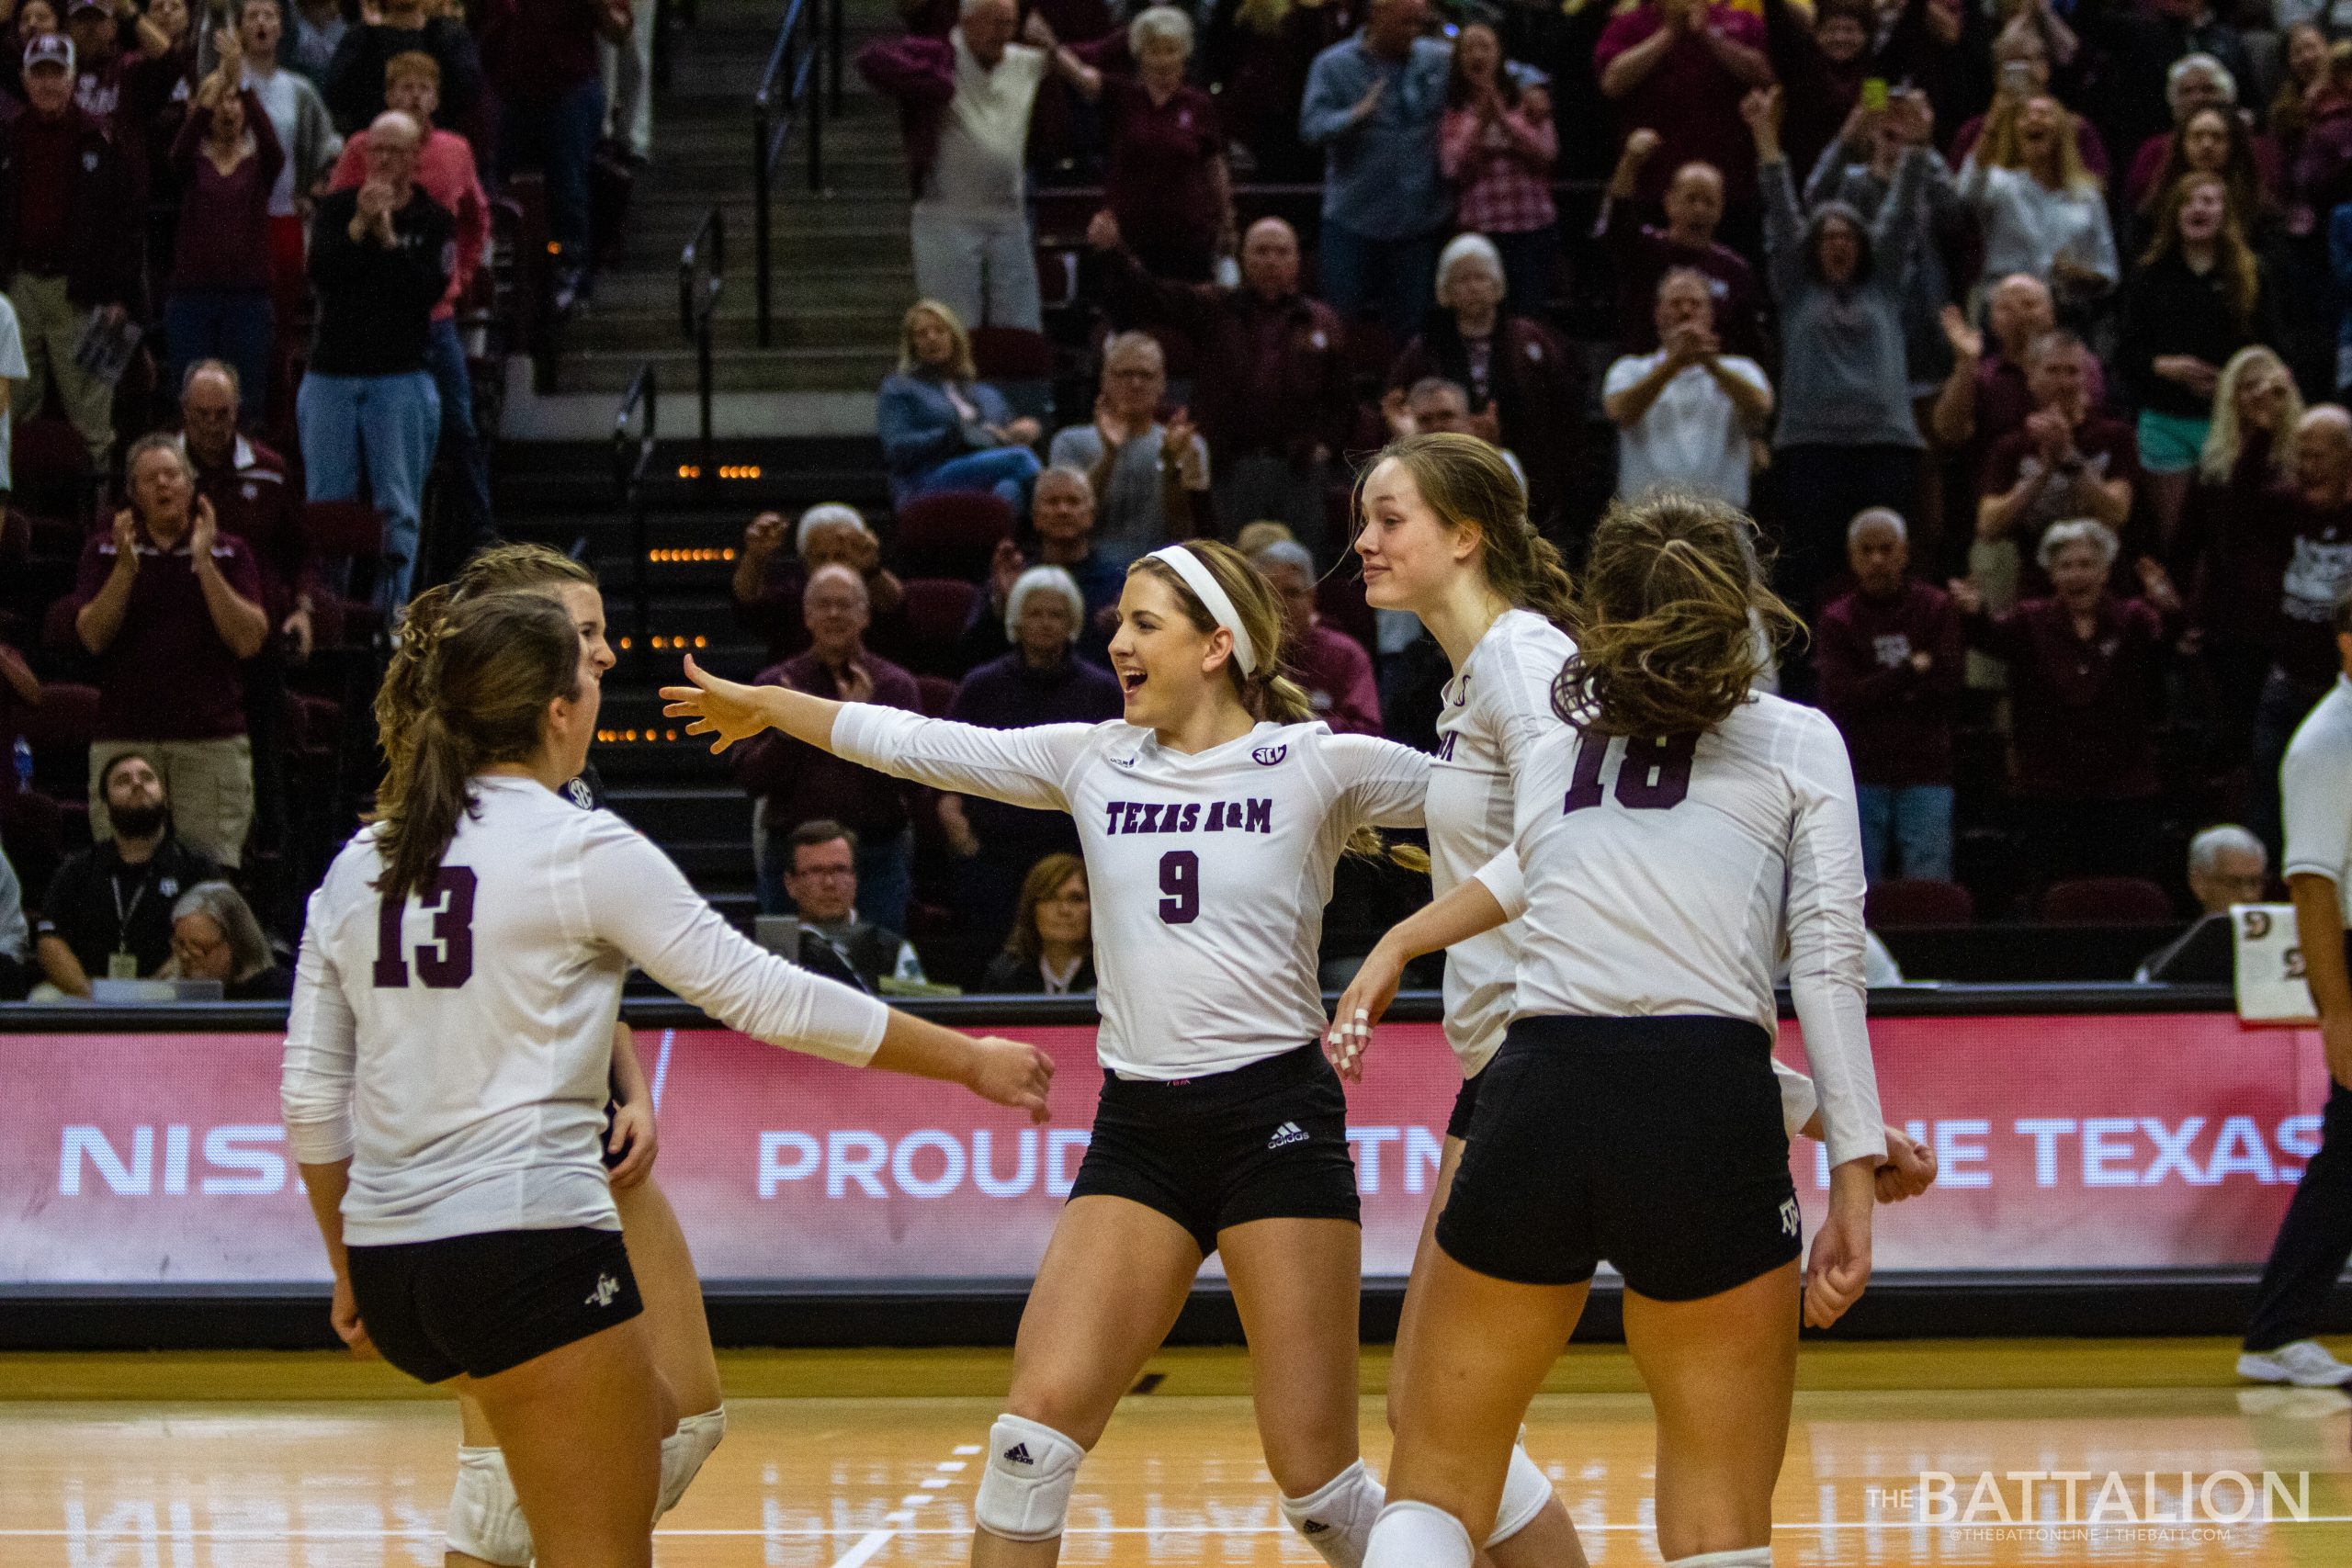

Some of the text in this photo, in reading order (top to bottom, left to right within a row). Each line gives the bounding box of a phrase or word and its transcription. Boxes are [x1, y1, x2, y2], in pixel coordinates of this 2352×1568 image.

[1563, 732, 1702, 816] 18
[1106, 798, 1272, 835] TEXAS A&M
[372, 866, 478, 988] 13
[1159, 851, 1200, 924] 9
[758, 1129, 1092, 1199] PROUD
[2014, 1116, 2325, 1187] TEXAS
